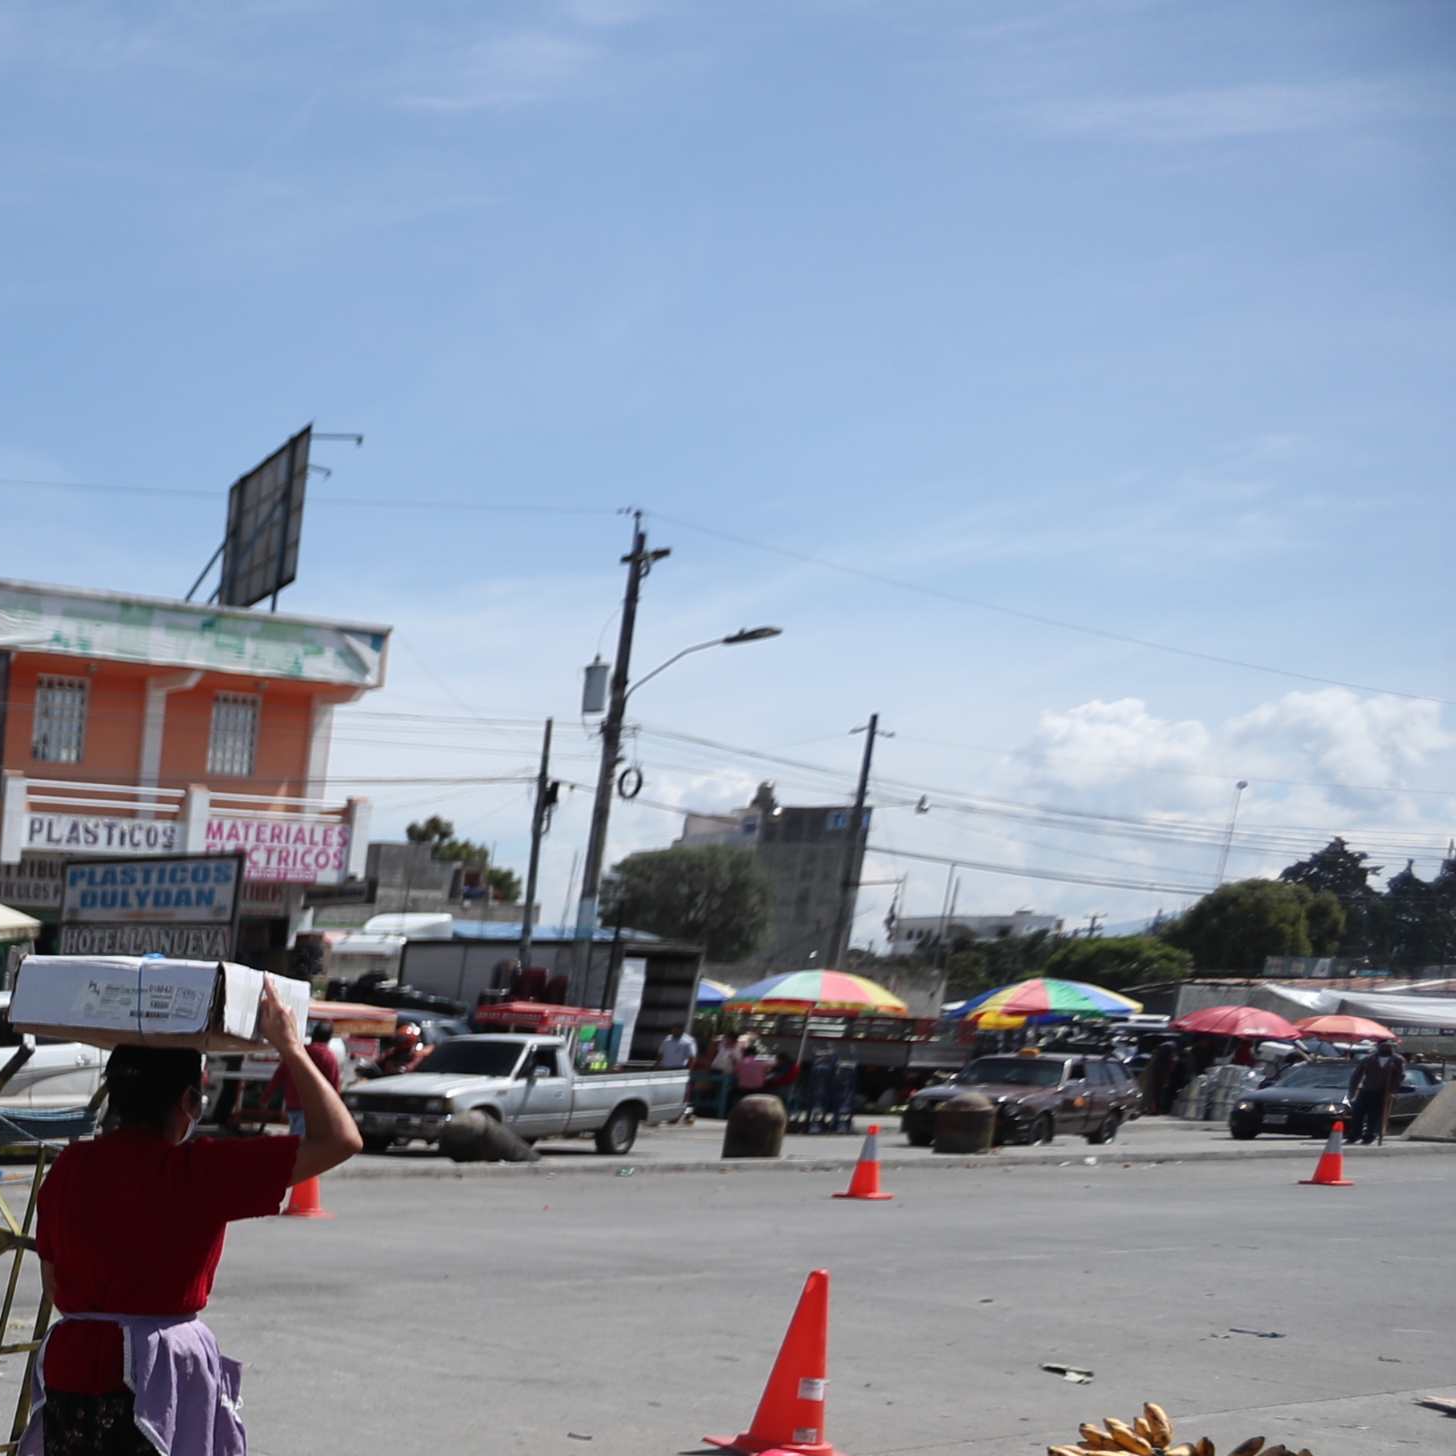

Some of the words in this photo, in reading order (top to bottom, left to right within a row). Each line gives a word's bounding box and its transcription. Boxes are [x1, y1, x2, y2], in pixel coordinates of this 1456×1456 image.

[27, 816, 177, 850] PLASTICOS
[204, 818, 349, 848] MATERIALES
[68, 861, 234, 889] PLASTICOS
[80, 886, 216, 910] DULYDAN
[63, 924, 129, 956] HOTEL
[128, 926, 156, 956] LA
[156, 926, 230, 959] NUEVA
